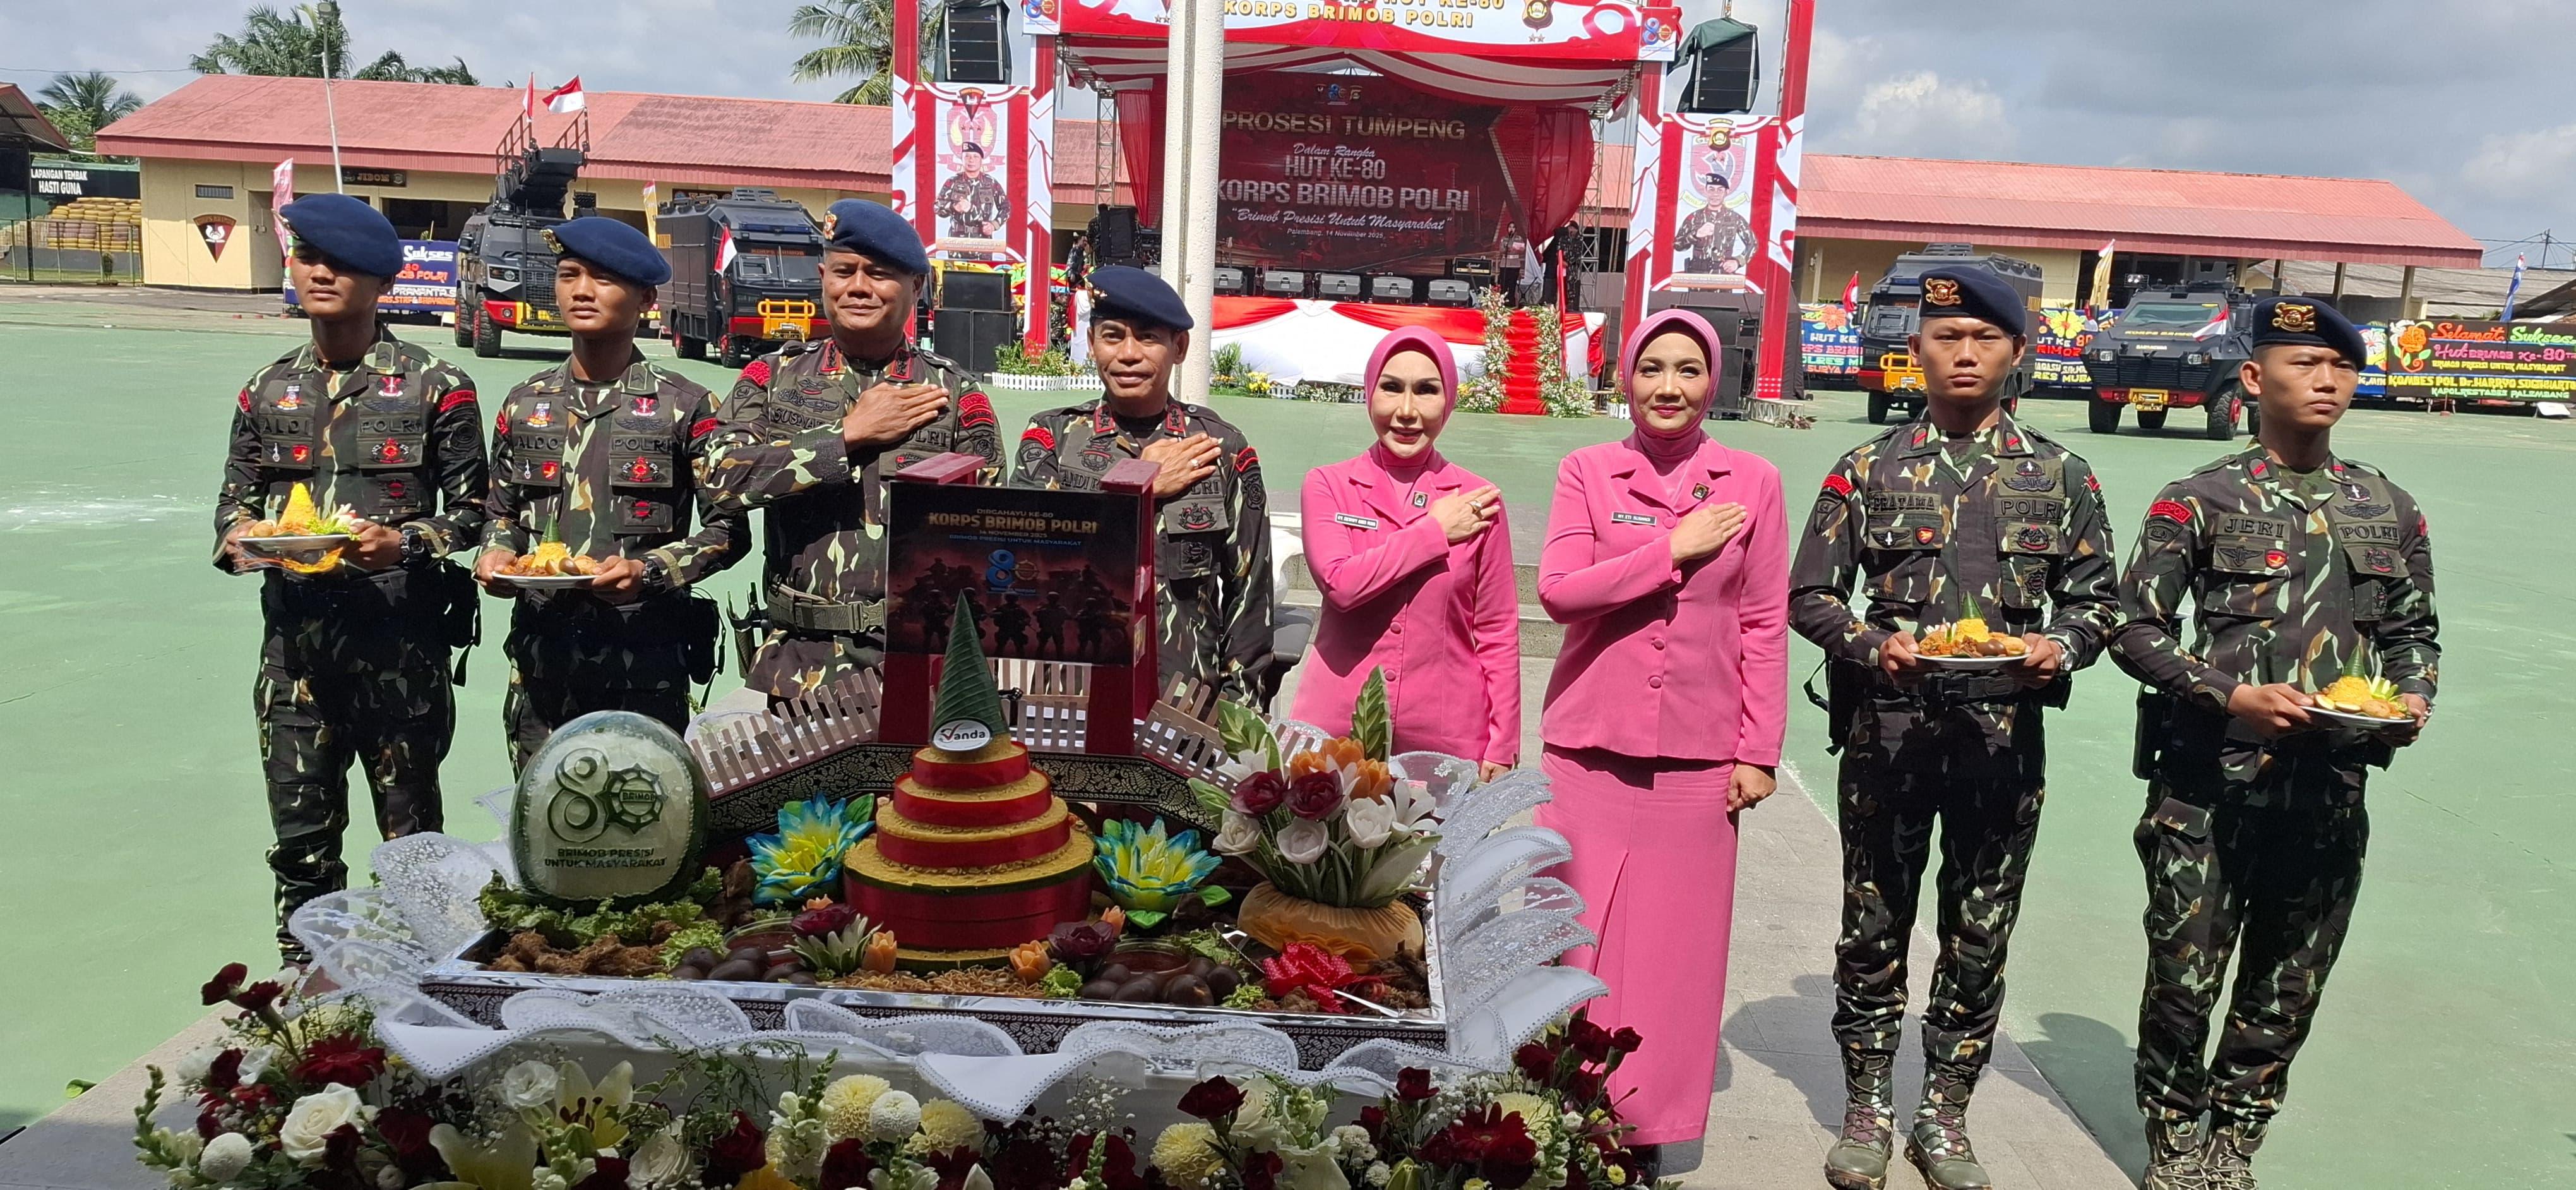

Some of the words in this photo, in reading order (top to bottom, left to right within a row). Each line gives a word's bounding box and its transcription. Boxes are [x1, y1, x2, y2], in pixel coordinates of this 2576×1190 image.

[1224, 0, 1297, 18] KORPS
[1308, 4, 1395, 25] BRIMOB
[1406, 9, 1473, 27] POLRI
[1222, 111, 1332, 134] PROSESI
[1342, 116, 1465, 140] TUMPENG
[1293, 143, 1330, 155] Dalam
[1334, 145, 1375, 159] Rangka
[31, 169, 63, 180] LAPANGAN
[64, 170, 88, 181] TEMBAK
[1285, 155, 1327, 178] HUT
[1331, 157, 1386, 180] KE-80
[39, 181, 59, 194] HASTI
[61, 182, 82, 195] GUNA
[1219, 179, 1290, 203] KORPS
[1297, 182, 1393, 209] BRIMOB
[1400, 188, 1470, 212] POLRI
[1282, 210, 1325, 225] Presisi
[1328, 215, 1365, 227] Untuk
[403, 245, 453, 262] Sukses
[417, 270, 448, 283] POLRI
[1810, 333, 1836, 342] HUT
[1839, 335, 1857, 343] KE
[2056, 337, 2071, 347] KE
[2431, 322, 2505, 342] Selamat
[2510, 326, 2576, 346] Sukses
[1808, 365, 1842, 374] SURYA
[2490, 362, 2515, 372] UNTUK
[2388, 375, 2434, 387] KOMBES
[2436, 376, 2458, 387] POL
[2510, 390, 2570, 399] PALEMBANG
[261, 418, 309, 436] ALDI
[360, 419, 422, 435] POLRI
[517, 435, 559, 450] ALDO
[612, 438, 671, 452] POLRI
[2001, 500, 2062, 519] POLRI
[929, 512, 980, 527] KORPS
[985, 515, 1046, 532] BRIMOB
[1051, 519, 1097, 534] POLRI
[2224, 518, 2285, 537] JERI
[2339, 525, 2399, 541] POLRI
[558, 848, 607, 857] BRIMOB
[609, 848, 655, 856] PRESISI
[545, 857, 584, 867] UNTUK
[586, 856, 667, 868] MASYARAKAT
